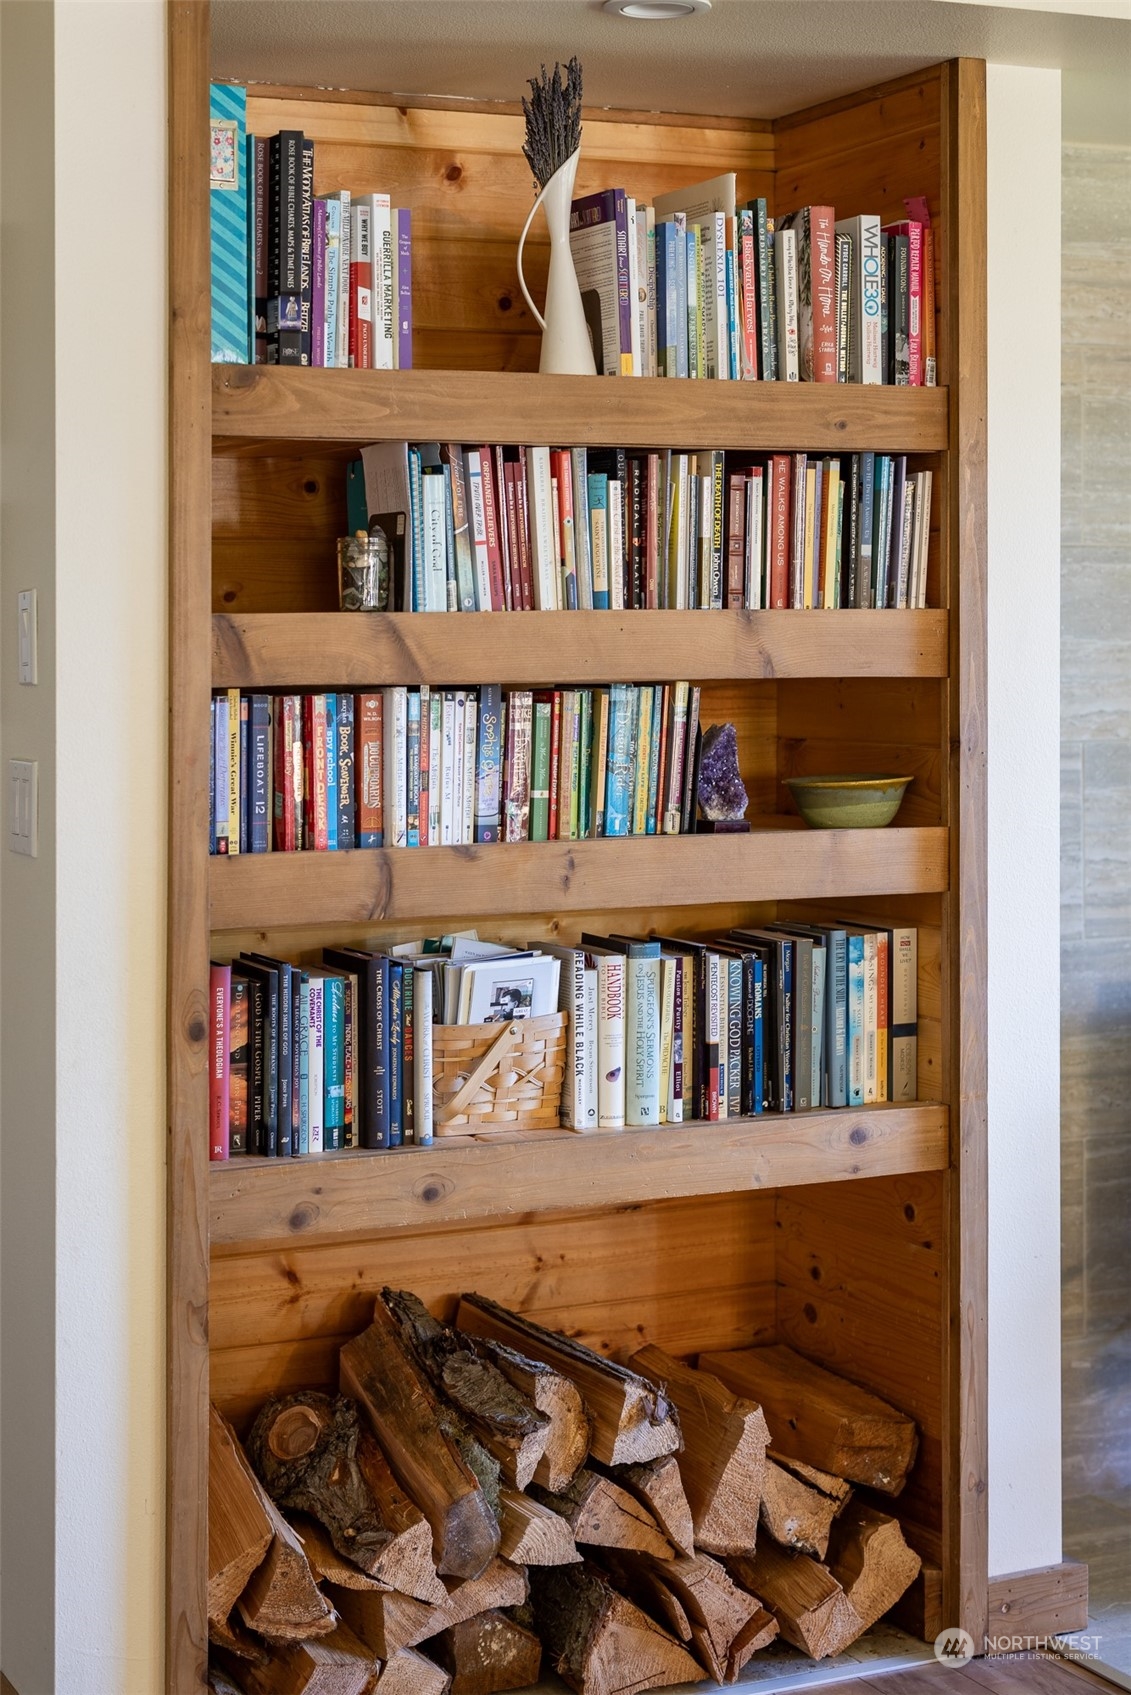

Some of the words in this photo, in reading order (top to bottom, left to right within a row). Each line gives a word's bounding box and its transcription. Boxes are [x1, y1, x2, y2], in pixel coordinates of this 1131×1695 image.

[257, 186, 264, 196] OF
[819, 219, 829, 228] The
[911, 228, 920, 249] PERIOD
[382, 230, 391, 282] GUERRILLA
[618, 230, 627, 256] SMART
[817, 232, 832, 284] Hands-On
[911, 250, 919, 270] REPAIR
[744, 240, 752, 290] Backyard
[864, 224, 879, 316] WHOLE30
[619, 268, 628, 305] SCATTERED
[818, 286, 833, 317] Home
[383, 284, 392, 339] MARKETING
[746, 293, 754, 333] Harvest
[910, 338, 918, 352] LARA
[910, 354, 919, 374] BRIDEN
[483, 461, 492, 505] ORPHANED
[779, 460, 786, 473] HE
[866, 473, 871, 481] HE
[429, 509, 441, 533] City
[487, 506, 495, 547] BELIEVERS
[714, 508, 722, 520] OF
[431, 534, 440, 546] of
[864, 530, 869, 538] US
[432, 548, 442, 571] God
[778, 553, 784, 566] US
[316, 726, 325, 779] FRONT
[326, 731, 335, 750] spy
[339, 726, 350, 755] BOOK
[368, 742, 380, 755] 100
[616, 711, 630, 760] Dragon
[256, 735, 265, 794] LIFEBOAT
[327, 752, 336, 786] school
[367, 755, 380, 808] CUPBOARDS
[614, 763, 628, 797] Rider
[339, 759, 351, 809] SCAVENGER
[255, 802, 265, 814] 12
[317, 783, 325, 830] DESK
[575, 952, 583, 999] READING
[601, 965, 605, 974] TO
[404, 968, 413, 1010] DOCTRINE
[606, 964, 622, 1020] HANDBOOK
[646, 972, 656, 1030] SPURGEON'S
[729, 961, 740, 1018] KNOWING
[316, 1023, 322, 1032] OF
[376, 1011, 382, 1020] OF
[575, 1003, 583, 1038] WHILE
[586, 1008, 594, 1032] Mercy
[404, 1027, 413, 1061] DANCES
[729, 1020, 740, 1047] GOD
[575, 1042, 584, 1076] BLACK
[646, 1032, 655, 1078] SERMONS
[729, 1050, 740, 1089] PACKER
[730, 1096, 740, 1112] IVP
